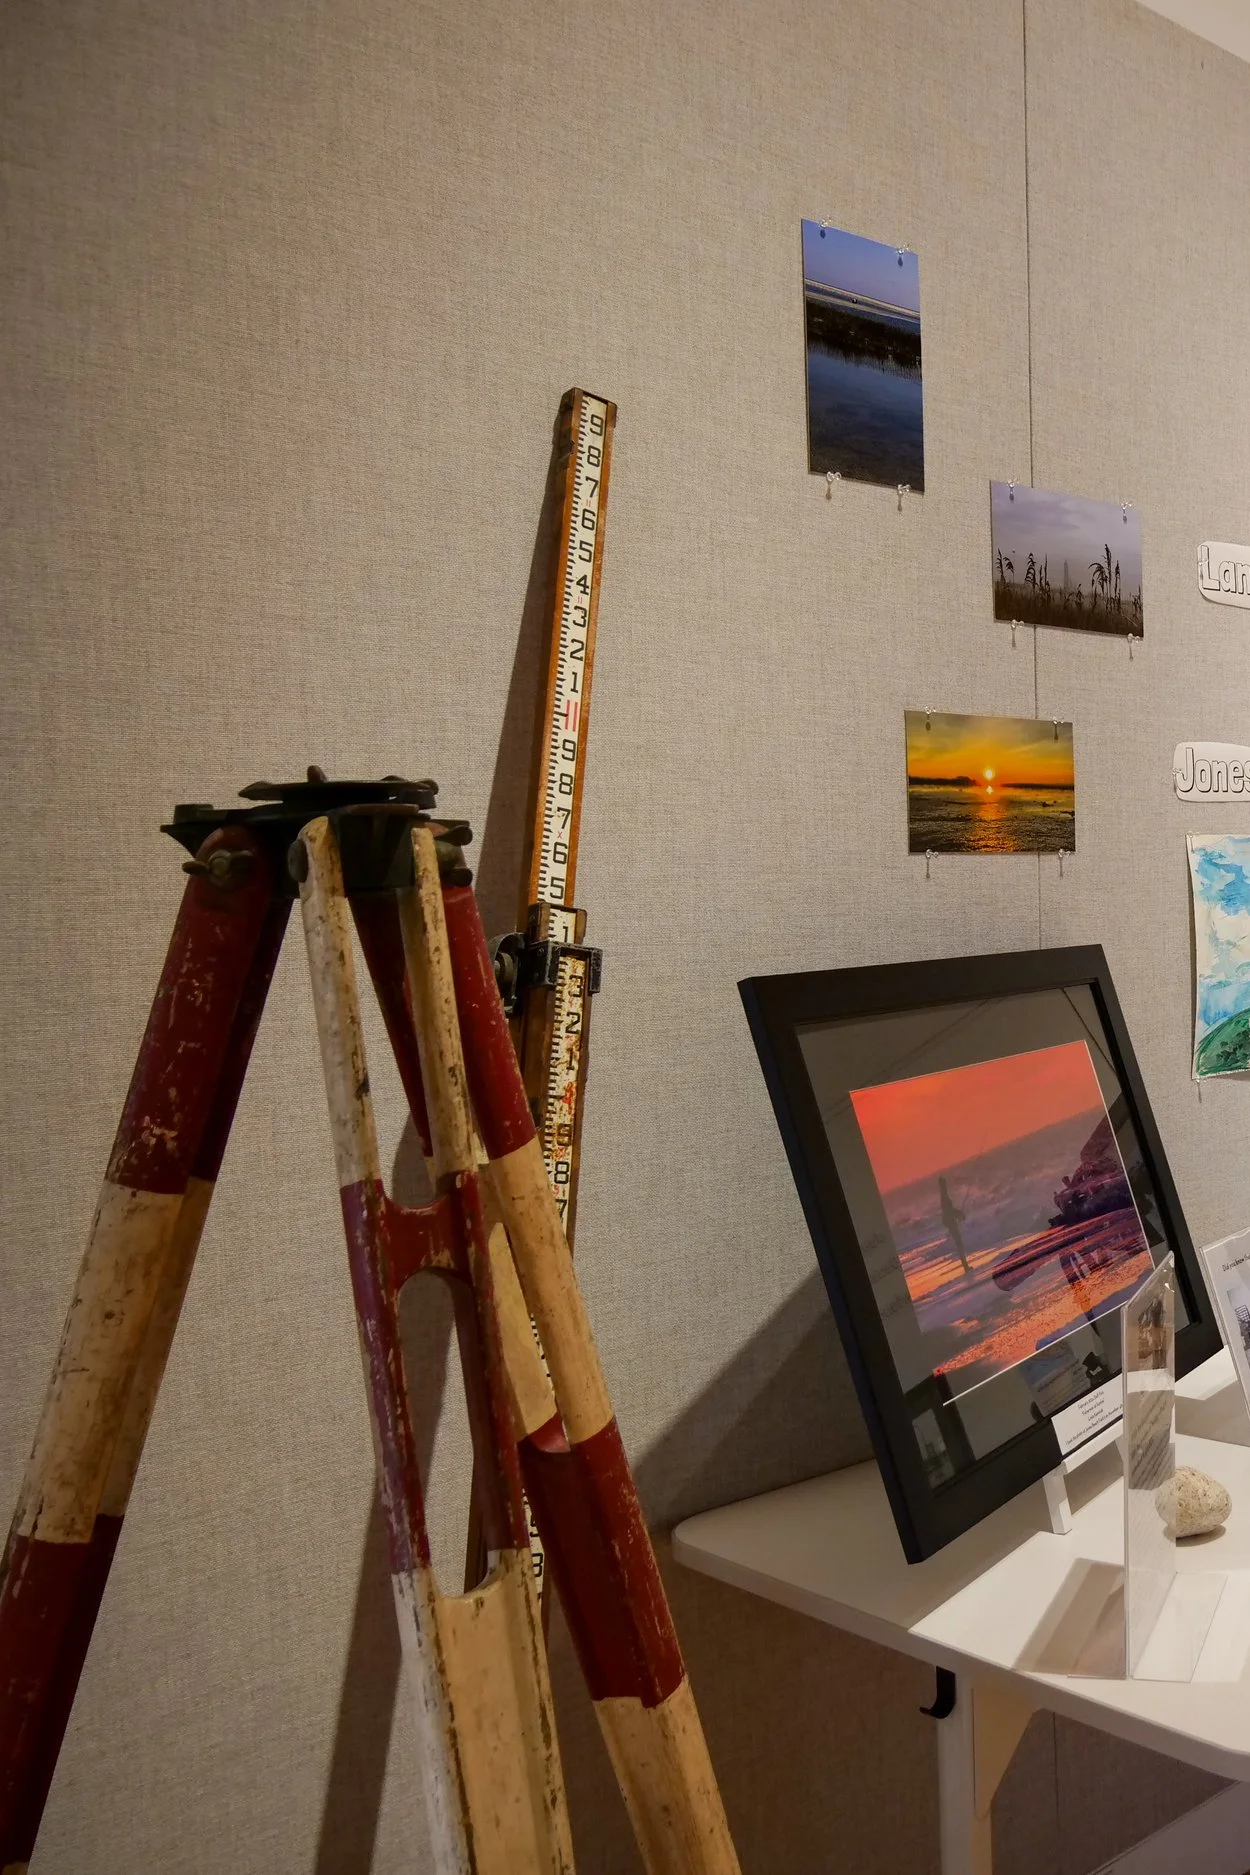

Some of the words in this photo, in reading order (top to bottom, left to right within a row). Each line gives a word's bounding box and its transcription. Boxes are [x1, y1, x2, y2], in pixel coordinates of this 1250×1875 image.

[590, 415, 604, 437] 9
[587, 445, 601, 467] 8
[585, 476, 599, 498] 7
[581, 508, 596, 531] 6
[578, 541, 593, 563] 5
[576, 574, 589, 595] 4
[572, 606, 587, 628] 3
[570, 639, 584, 662] 2
[570, 672, 578, 693] 1
[562, 739, 577, 761] 9
[559, 773, 573, 795] 8
[557, 807, 571, 829] 7
[553, 842, 567, 864] 6
[550, 876, 564, 899] 5
[569, 975, 583, 998] 3
[565, 1012, 580, 1035] 2
[554, 1161, 569, 1185] 8
